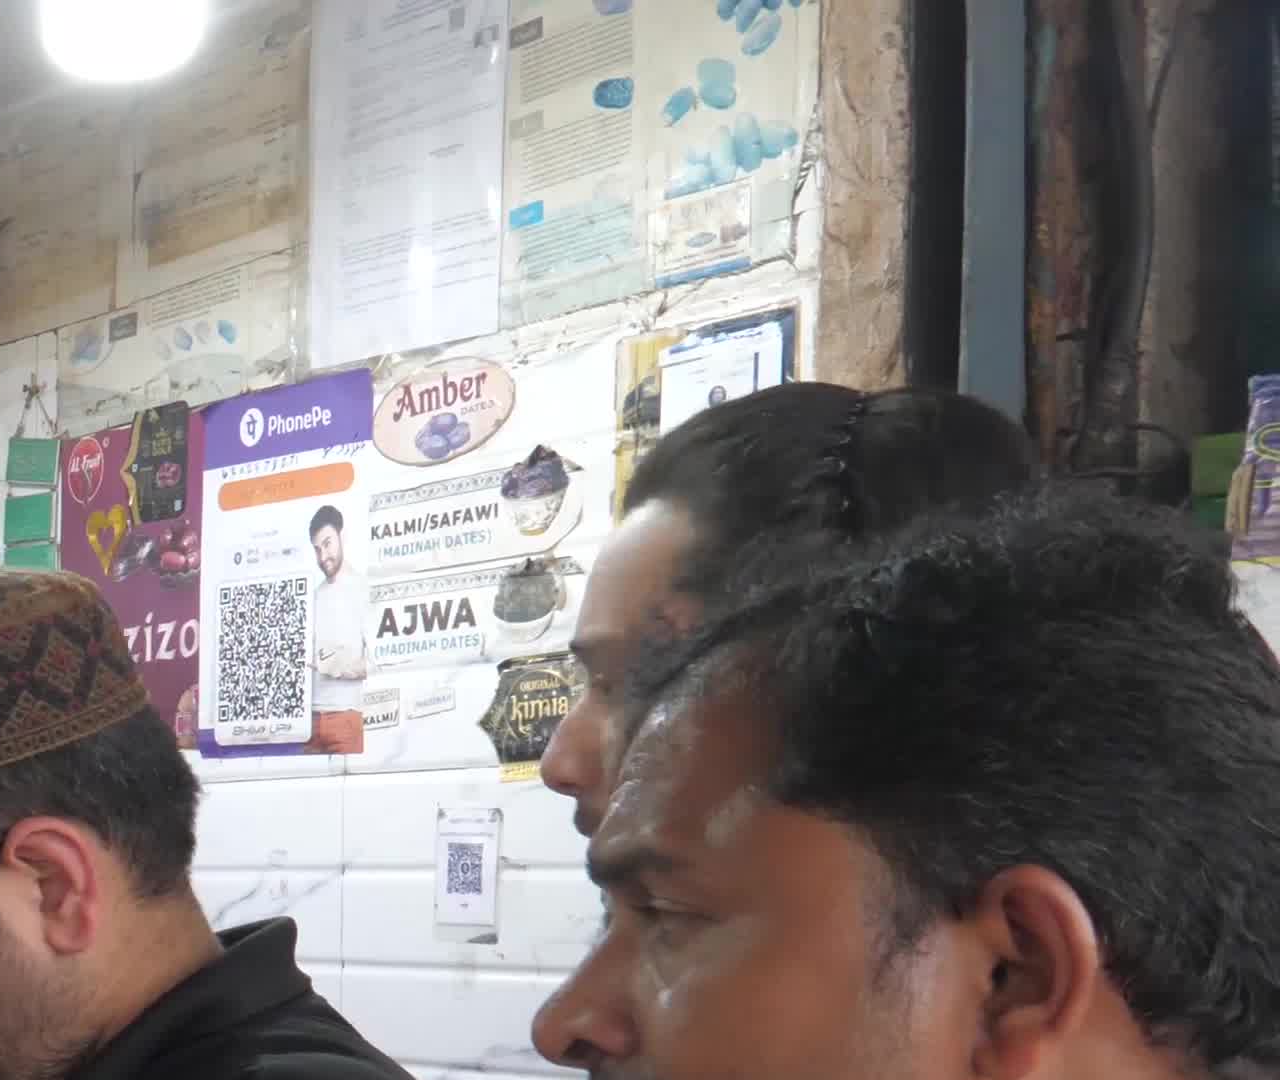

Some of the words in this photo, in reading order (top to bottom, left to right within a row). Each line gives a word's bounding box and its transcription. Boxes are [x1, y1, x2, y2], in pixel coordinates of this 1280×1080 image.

[393, 371, 488, 422] Amber
[268, 406, 332, 437] PhonePe
[370, 502, 500, 541] KALMI/SAFAWI
[378, 536, 441, 562] (MADINAH
[444, 528, 493, 550] DATES)
[376, 597, 477, 640] AJWA
